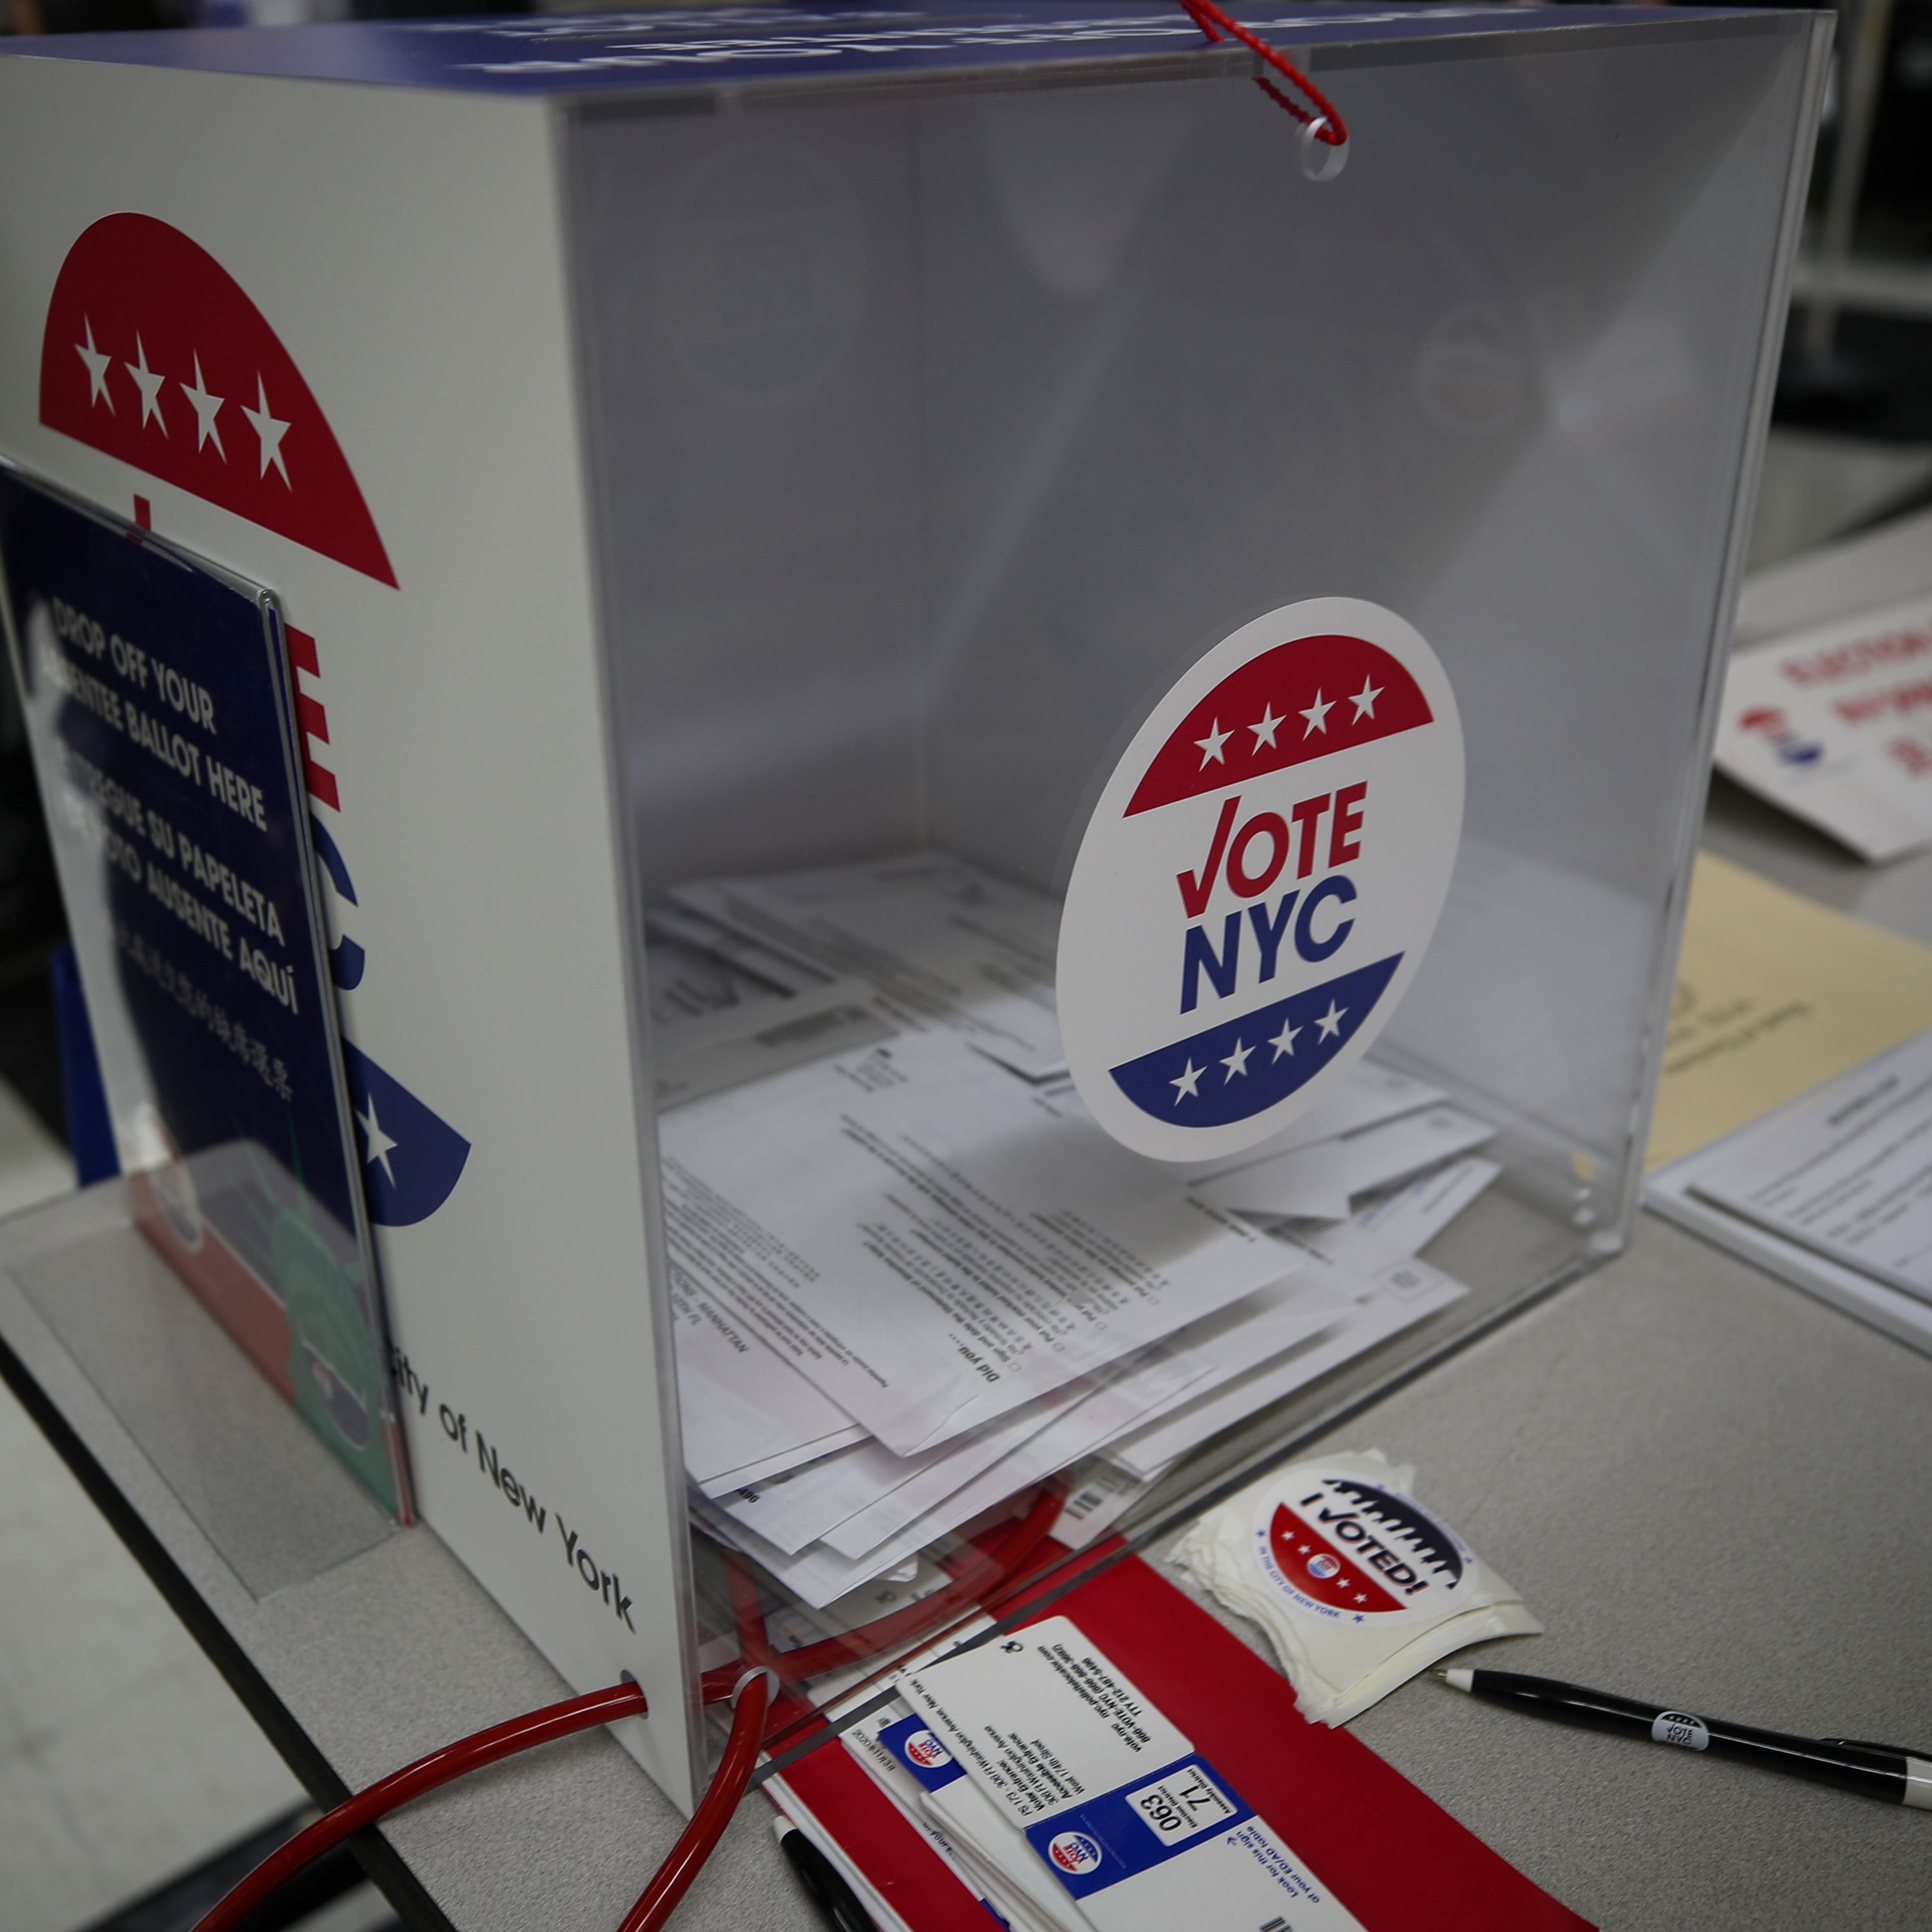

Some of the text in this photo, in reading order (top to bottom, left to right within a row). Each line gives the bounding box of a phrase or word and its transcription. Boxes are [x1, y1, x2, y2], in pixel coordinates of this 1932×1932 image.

[52, 596, 217, 735] DROP OFF YOUR
[124, 699, 201, 786] BALLOT
[205, 755, 267, 833] HERE
[1175, 781, 1368, 920] VOTE
[147, 809, 174, 860] SU
[178, 832, 286, 948] PAPELETA
[147, 861, 233, 961] AUSENTE
[240, 935, 298, 1016] AQUÍ
[1179, 875, 1358, 1016] NYC
[695, 1302, 750, 1352] MANHATTAN
[961, 1322, 981, 1337] date
[977, 1336, 995, 1349] and
[991, 1347, 1012, 1362] Sign
[974, 1363, 1001, 1383] Did
[395, 1347, 636, 1636] ity of New York
[732, 1484, 760, 1504] 496
[1300, 1492, 1324, 1508] I
[1318, 1507, 1429, 1596] VOTED!
[1263, 1555, 1274, 1571] THE
[1270, 1570, 1284, 1586] CITY
[1282, 1585, 1294, 1595] OF
[1293, 1593, 1314, 1608] NEW
[1315, 1603, 1341, 1618] YORK
[907, 1680, 926, 1694] York
[920, 1694, 938, 1709] New
[1097, 1692, 1151, 1744] 866-VOTE-NYC
[1122, 1700, 1142, 1716] TTY
[916, 1741, 937, 1761] VOTE
[924, 1738, 942, 1756] NYC
[952, 1731, 992, 1767] Washington
[981, 1725, 1008, 1750] Avenue
[1110, 1722, 1142, 1752] vote.nyc
[983, 1766, 996, 1776] Ft
[1002, 1747, 1041, 1785] Washington
[1029, 1739, 1086, 1794] West 174th Street
[1034, 1762, 1073, 1799] Accessible
[1005, 1792, 1023, 1805] 173
[1023, 1790, 1045, 1810] Voter
[1157, 1785, 1198, 1828] Election District
[1178, 1785, 1210, 1809] 71
[1186, 1768, 1231, 1815] Assembly District
[1016, 1804, 1033, 1816] PS
[1138, 1794, 1182, 1832] 063
[1059, 1844, 1084, 1865] VOTE
[1068, 1842, 1088, 1861] NYC
[1235, 1830, 1298, 1897] Look for this sign
[1245, 1825, 1320, 1904] at your ED/AD table
